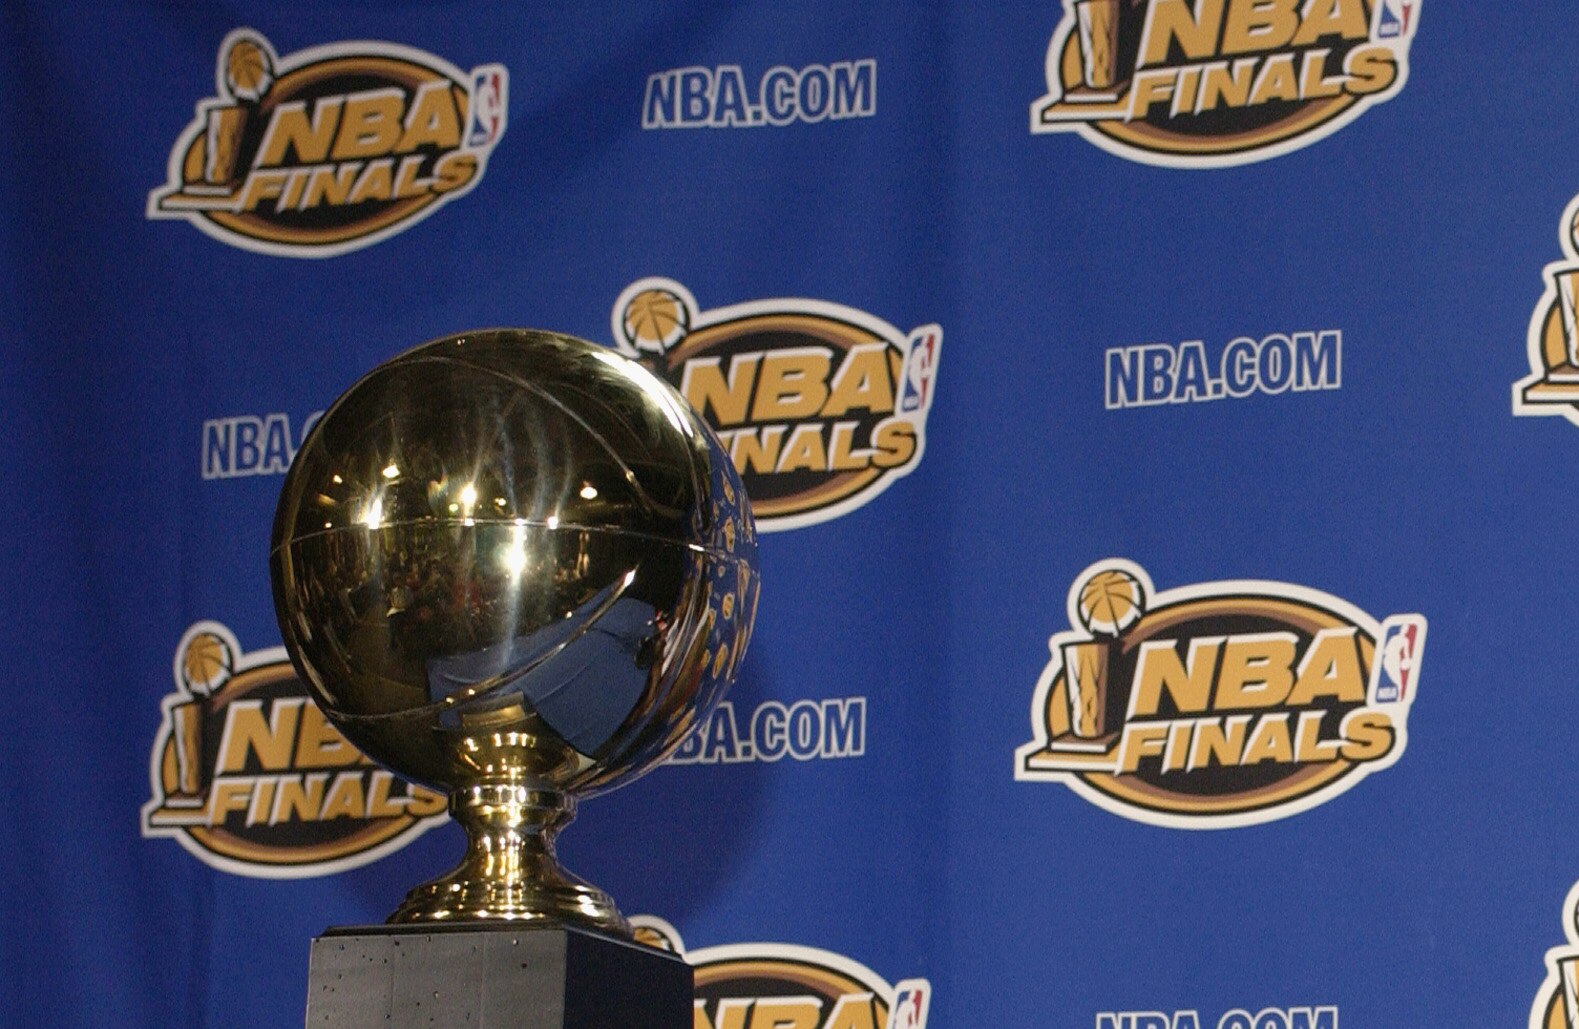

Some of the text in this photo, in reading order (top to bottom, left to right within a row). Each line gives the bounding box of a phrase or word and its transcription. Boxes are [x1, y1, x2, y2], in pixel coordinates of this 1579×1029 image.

[642, 58, 877, 129] NBA.COM
[1124, 47, 1395, 122] FINALS
[252, 80, 460, 168] NBA
[235, 154, 478, 214] FINALS
[681, 342, 895, 427] NBA
[1105, 329, 1342, 409] NBA.COM
[1126, 626, 1367, 722] NBA
[1114, 711, 1393, 777] FINALS
